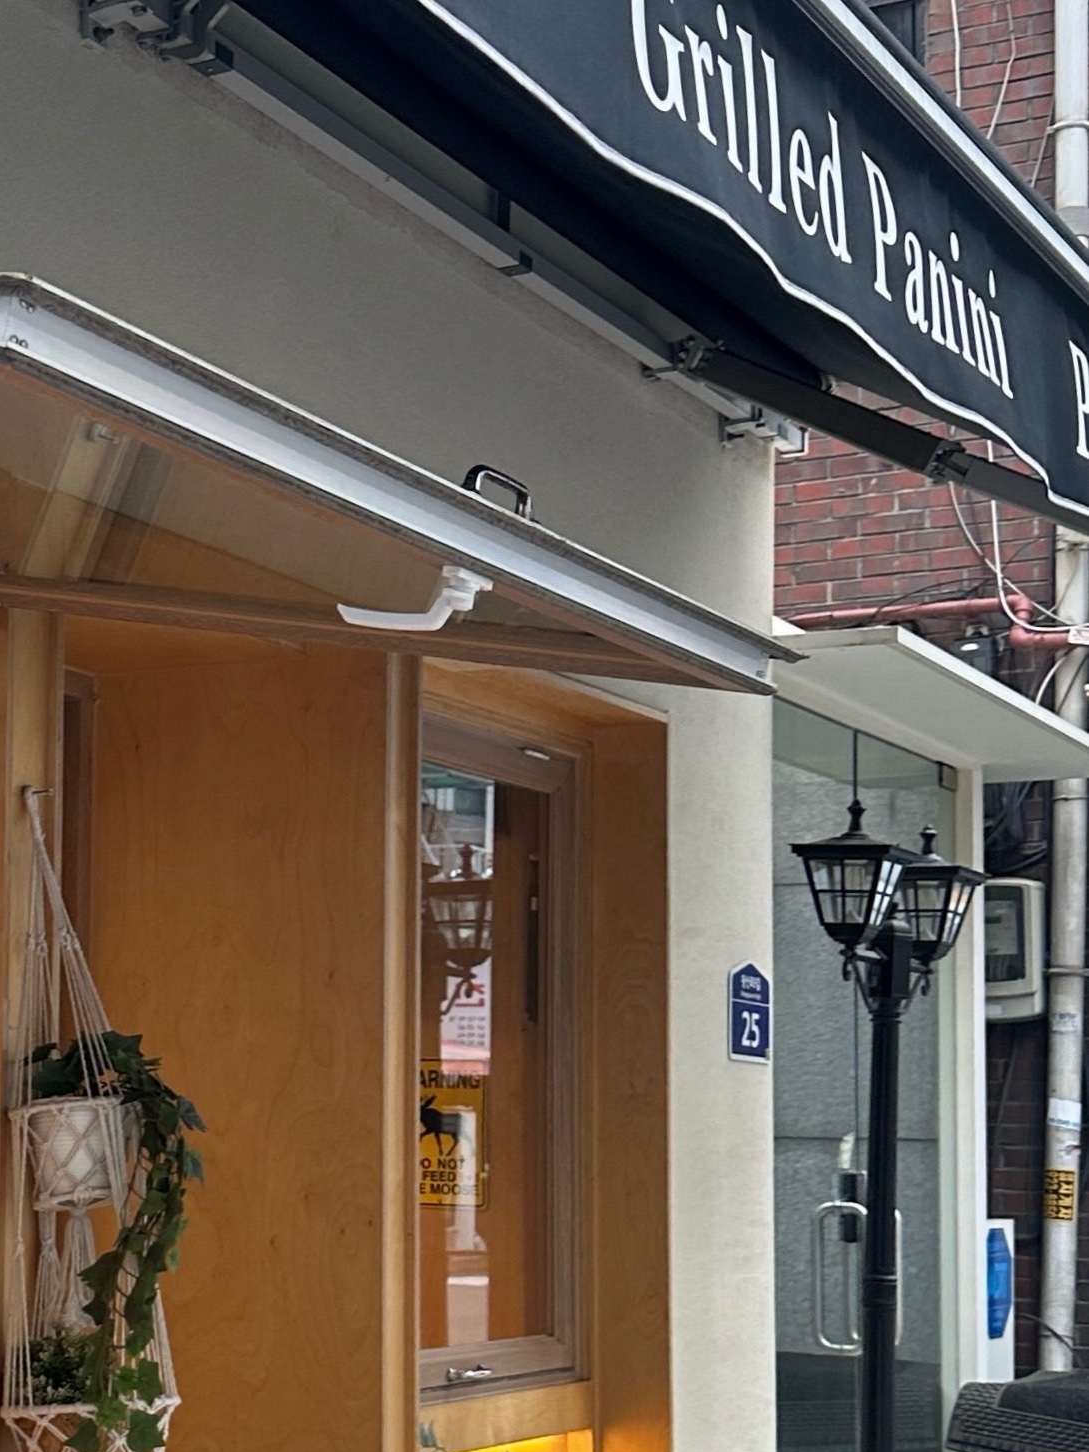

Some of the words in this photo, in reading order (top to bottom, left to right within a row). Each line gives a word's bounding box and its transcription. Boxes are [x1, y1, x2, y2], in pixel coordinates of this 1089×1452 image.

[631, 0, 853, 264] Grilled
[861, 150, 1014, 400] Panini
[741, 1010, 761, 1048] 25
[420, 1069, 481, 1089] ARNING
[420, 1157, 431, 1169] O
[437, 1157, 465, 1170] NOT
[422, 1170, 457, 1182] FEED
[429, 1183, 478, 1195] MOOSE
